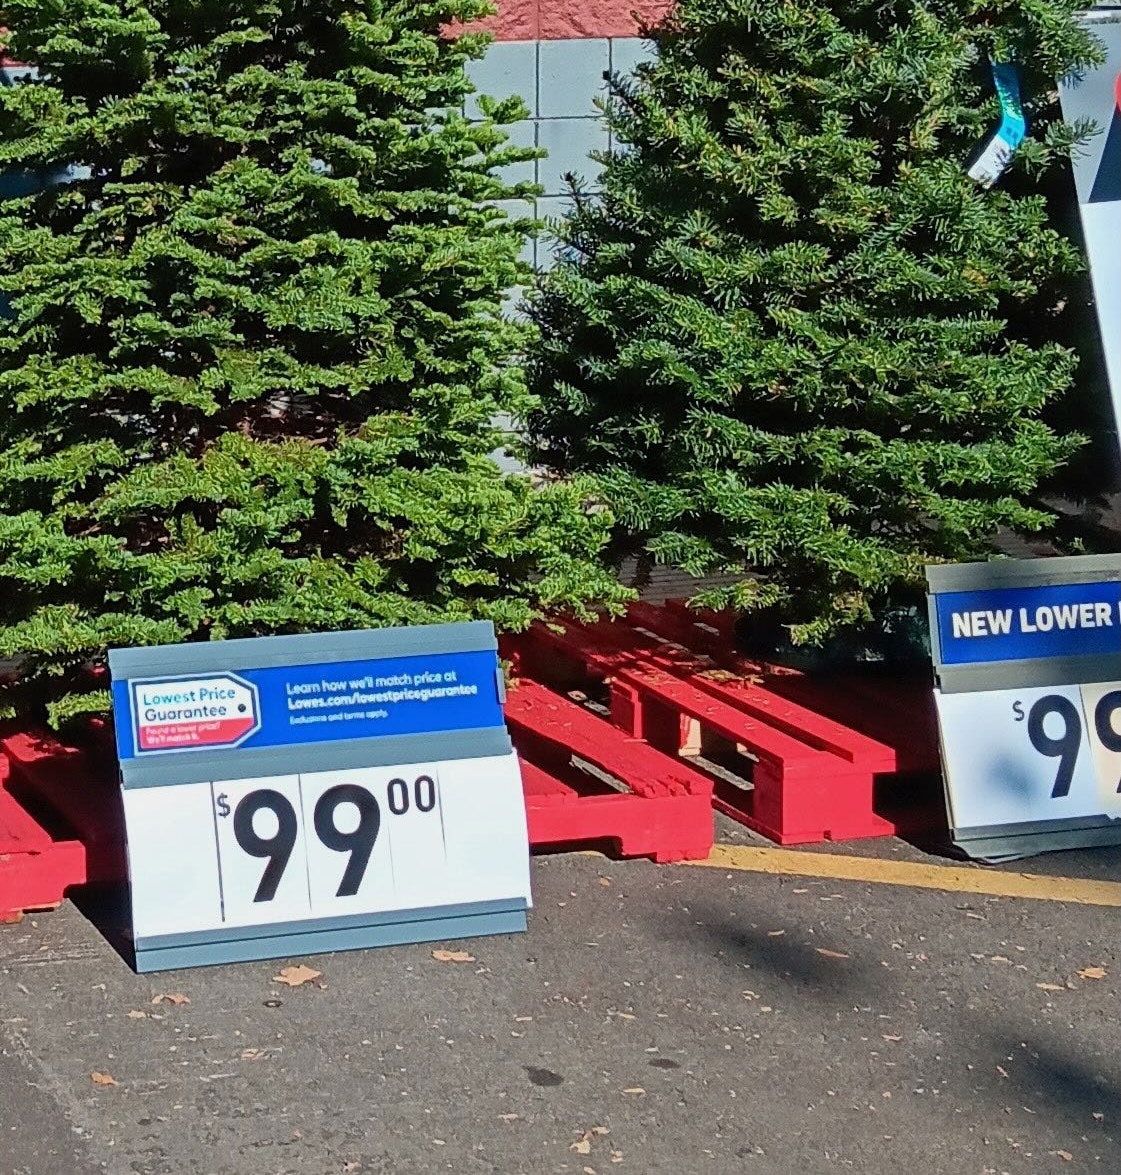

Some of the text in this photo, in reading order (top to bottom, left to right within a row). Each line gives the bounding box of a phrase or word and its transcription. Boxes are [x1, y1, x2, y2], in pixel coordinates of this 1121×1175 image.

[952, 609, 1013, 638] NEW
[1019, 602, 1113, 633] LOWER
[286, 669, 457, 695] Learn how we'll match price at
[143, 687, 236, 705] Lowest Price
[287, 684, 478, 710] Lowes.com/lowestpriceguarantee
[145, 706, 226, 721] Guarantee
